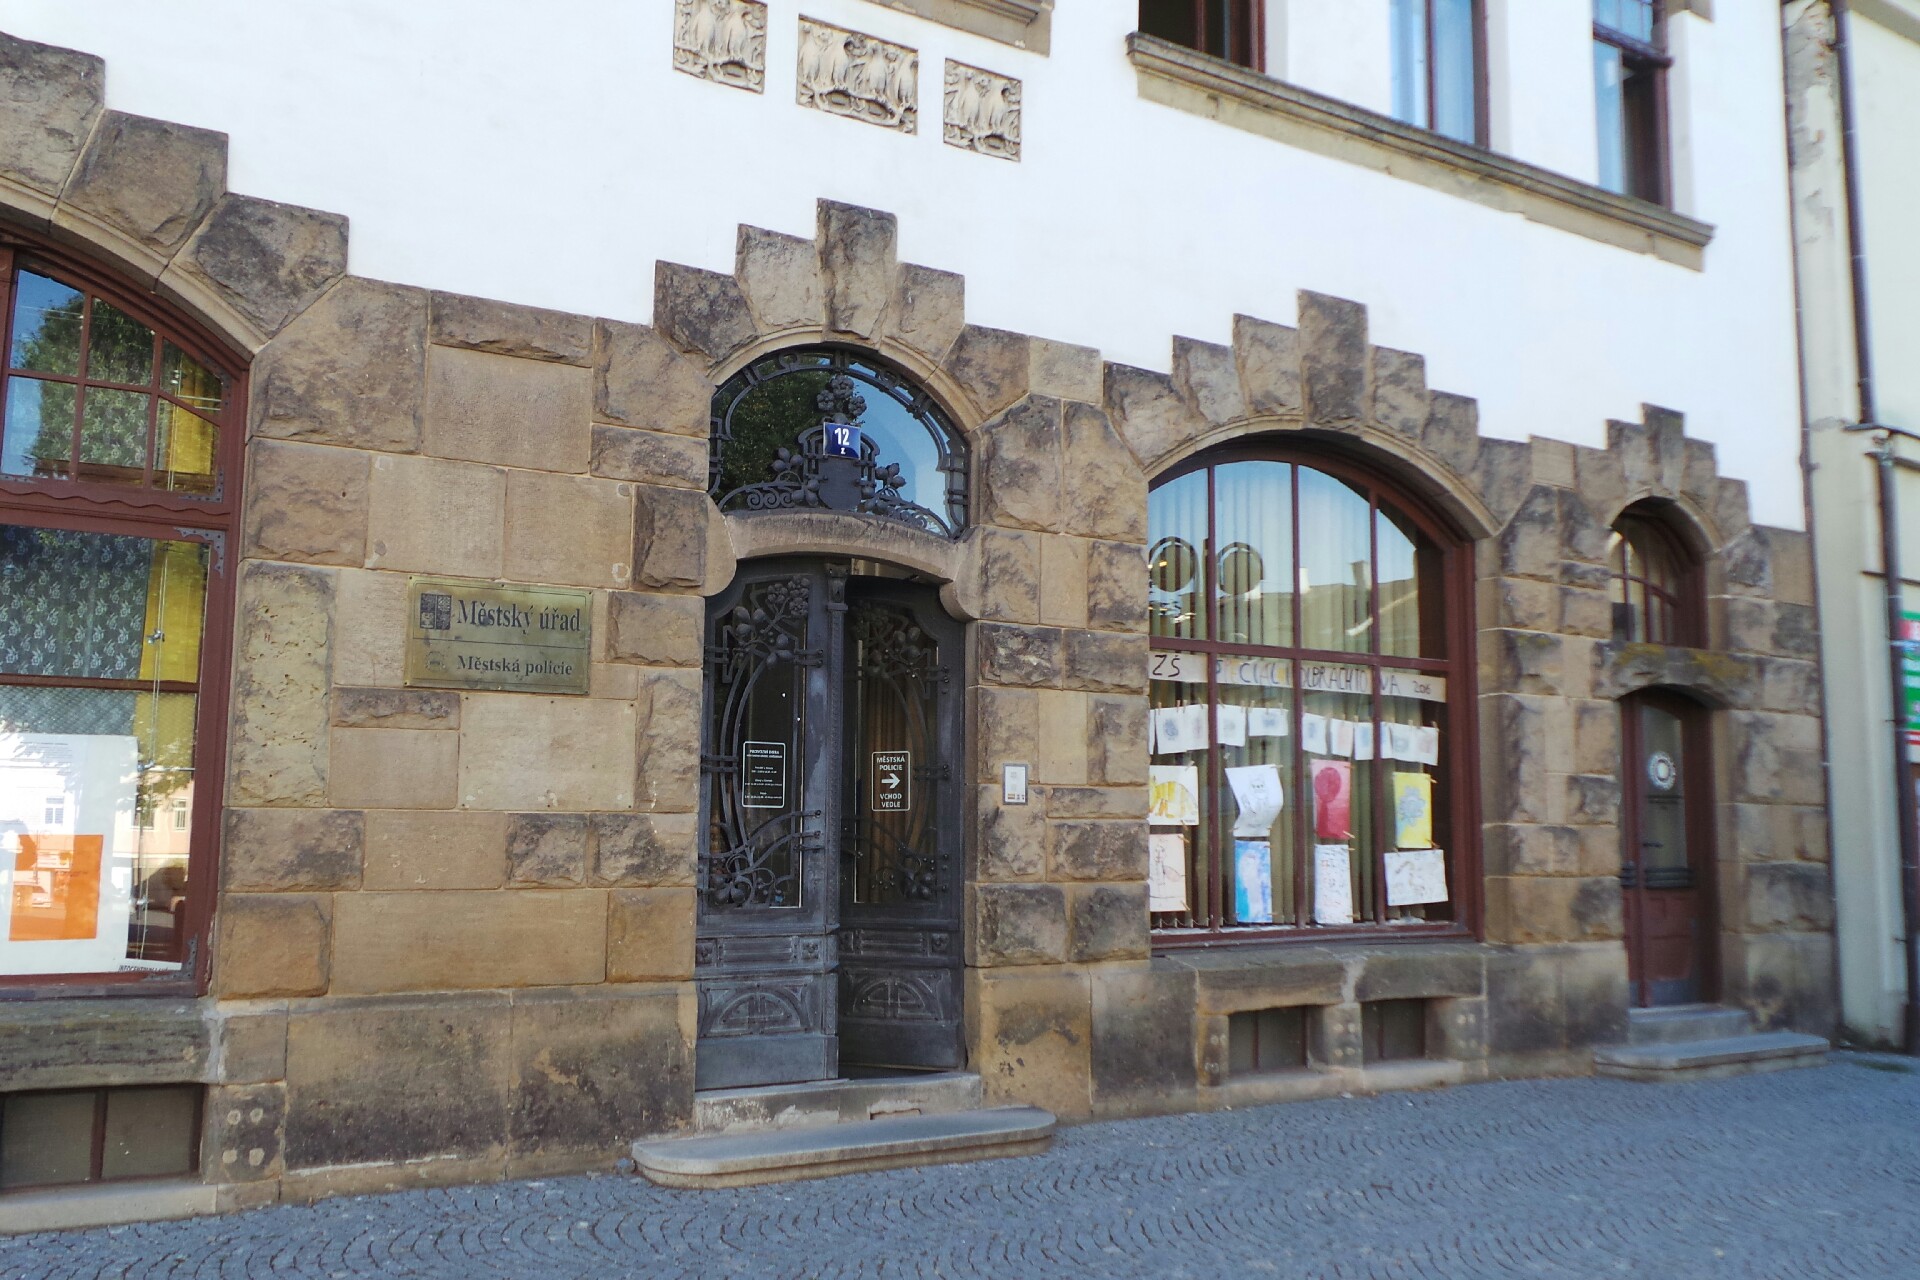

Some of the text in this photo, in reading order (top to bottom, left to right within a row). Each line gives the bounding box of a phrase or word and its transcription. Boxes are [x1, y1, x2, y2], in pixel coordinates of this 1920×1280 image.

[834, 427, 850, 445] 12
[457, 599, 581, 635] Městský úřad
[457, 655, 573, 677] Městská policie
[876, 755, 905, 763] MĚSTSKÁ
